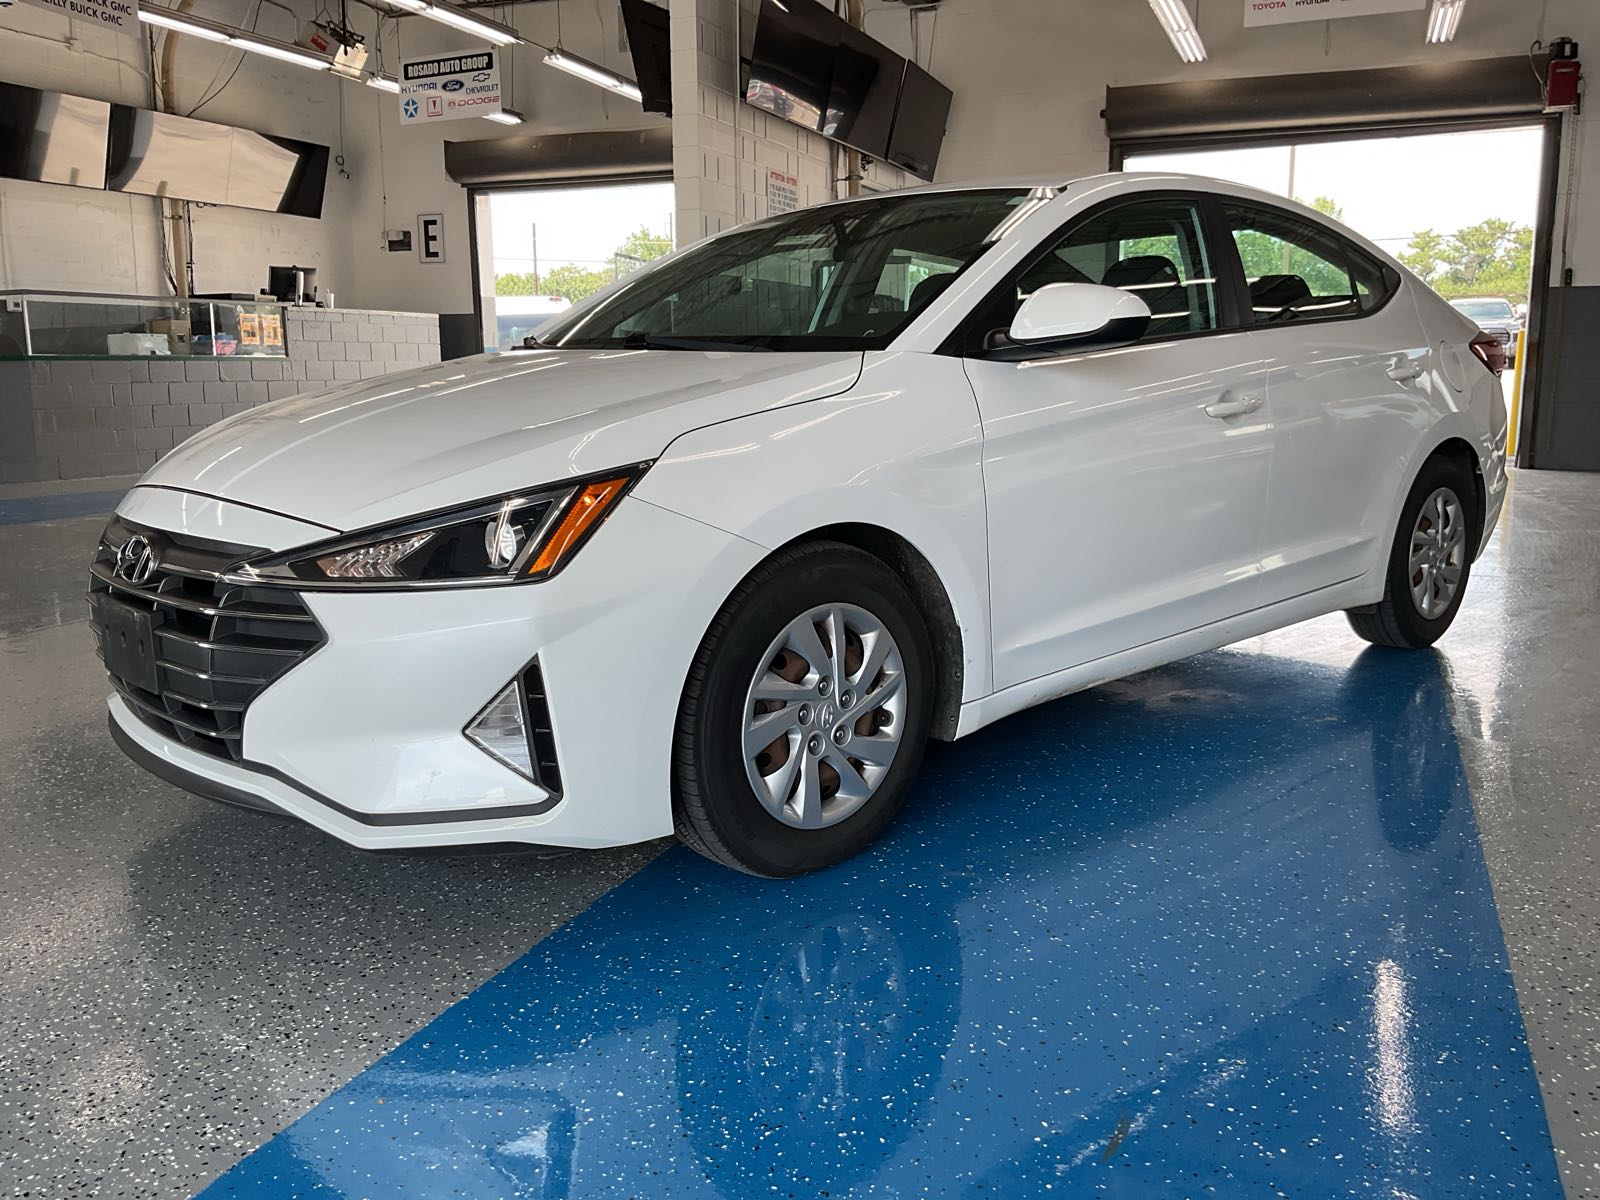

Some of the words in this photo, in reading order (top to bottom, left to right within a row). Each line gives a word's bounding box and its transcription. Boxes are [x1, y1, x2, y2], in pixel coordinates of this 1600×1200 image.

[110, 1, 131, 15] GMC
[1252, 1, 1286, 11] TOYOTA
[70, 1, 98, 19] BUICK
[101, 11, 122, 26] GMC
[408, 63, 438, 77] ROSADO
[440, 60, 460, 73] AUTO
[461, 56, 488, 70] GROUP
[401, 82, 437, 94] HYUNDAI
[466, 84, 499, 94] CHEVROLET
[458, 96, 500, 106] DODGE
[423, 219, 439, 258] E
